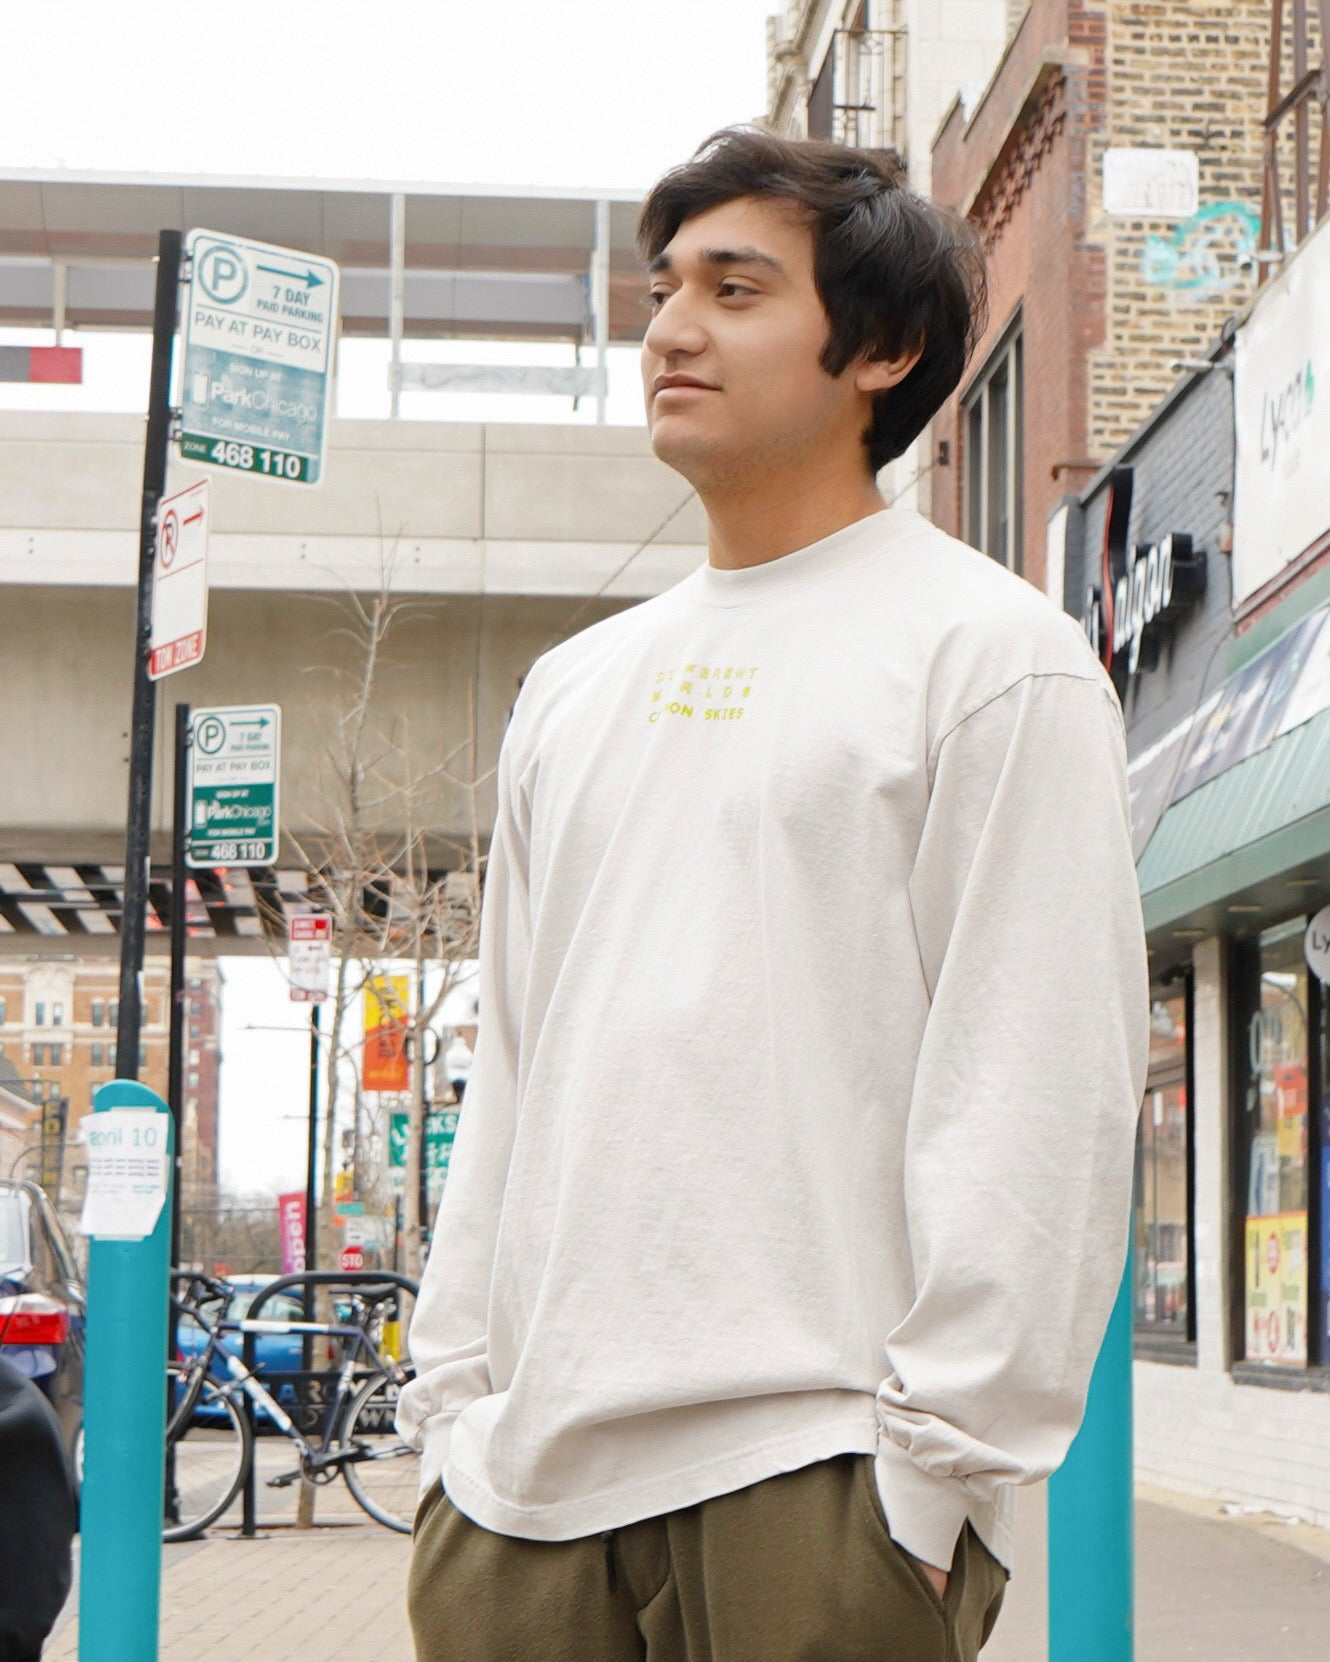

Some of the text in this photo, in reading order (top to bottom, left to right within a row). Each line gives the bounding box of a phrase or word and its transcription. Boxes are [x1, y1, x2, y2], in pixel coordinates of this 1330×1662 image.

[273, 285, 311, 306] 7 DAY
[256, 299, 323, 323] PAID PARKING
[195, 311, 322, 352] PAY AT PAY BOX
[211, 441, 254, 469] 468
[260, 450, 301, 478] 110
[704, 707, 744, 721] SKIES
[211, 843, 237, 859] 468
[240, 842, 265, 859] 110
[133, 1127, 158, 1147] 10
[341, 1252, 364, 1270] STO
